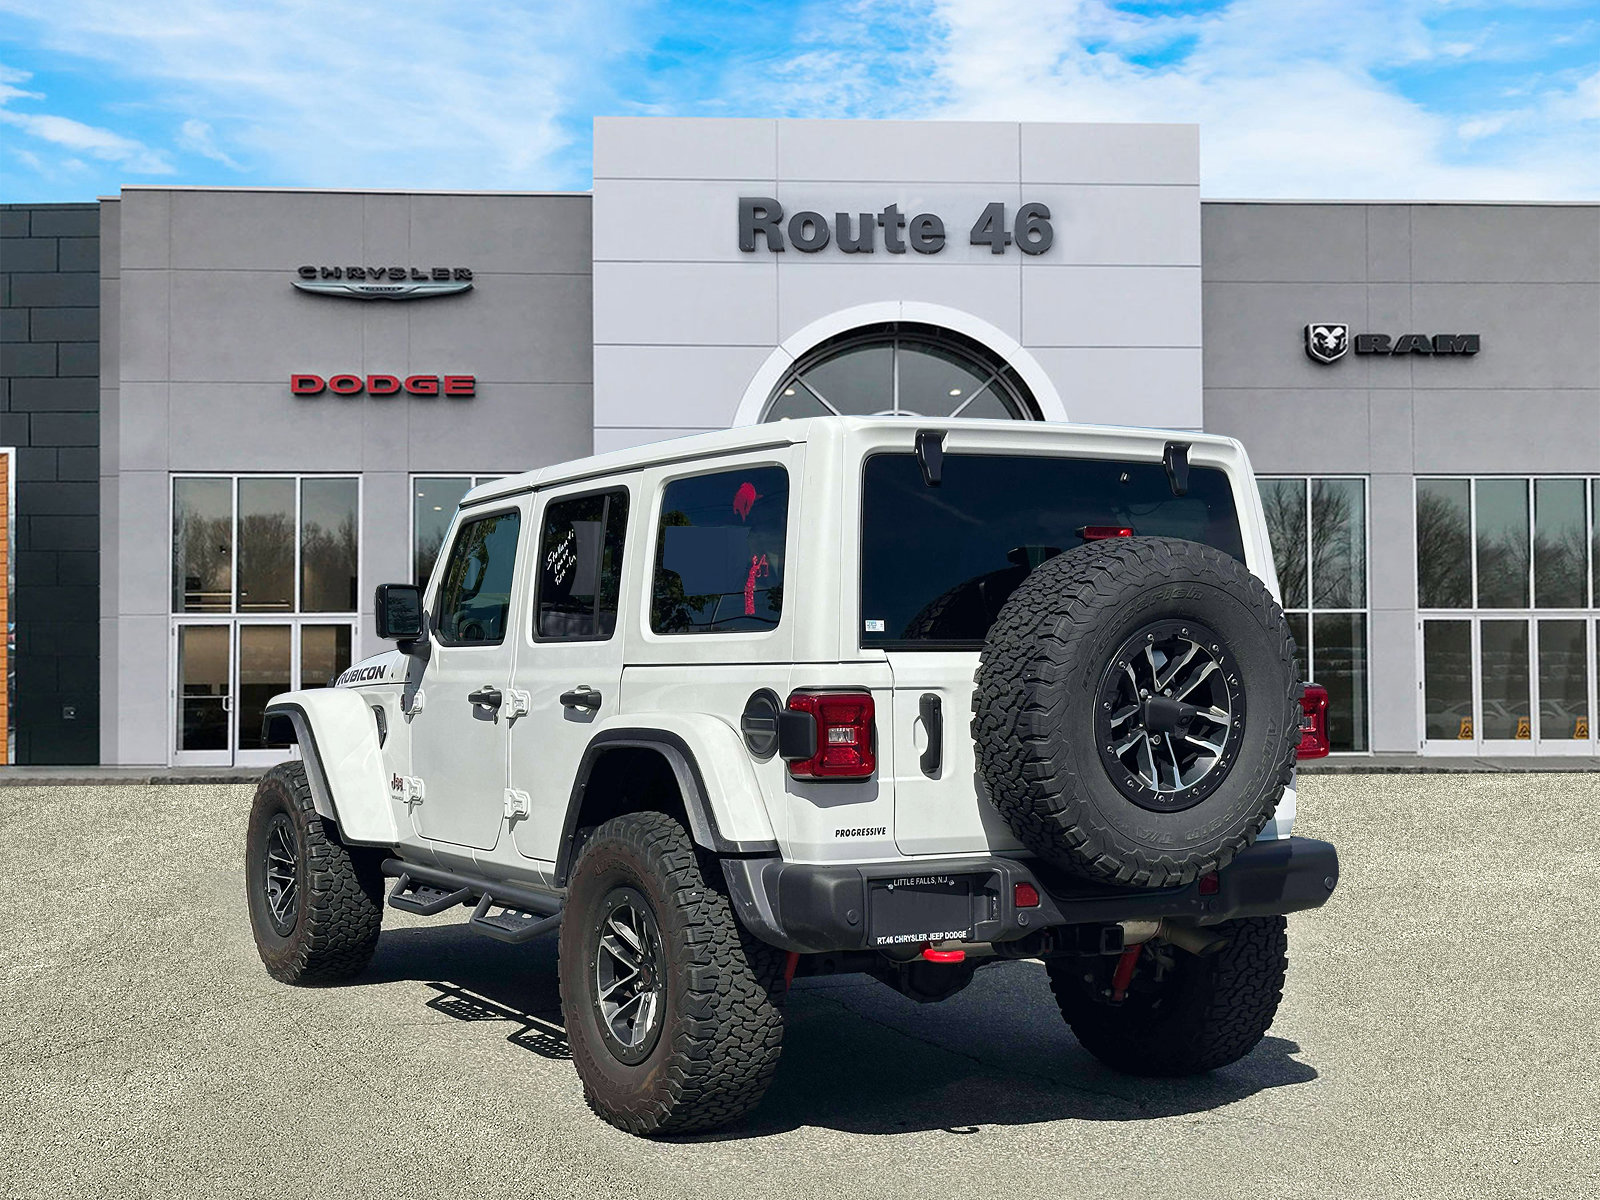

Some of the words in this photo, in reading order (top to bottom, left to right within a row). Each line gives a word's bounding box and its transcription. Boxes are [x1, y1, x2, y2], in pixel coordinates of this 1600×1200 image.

[739, 196, 946, 254] Route
[970, 202, 1054, 256] 46
[298, 266, 473, 281] CHRYSLER
[1354, 333, 1480, 355] RAM
[290, 374, 476, 396] DODGE
[336, 664, 388, 687] RUBICON
[835, 826, 887, 838] PROGRESSIVE
[893, 877, 915, 887] LITTLE
[894, 933, 928, 944] CHRYSLER
[928, 931, 944, 941] JEEP
[944, 930, 967, 940] DODGE
